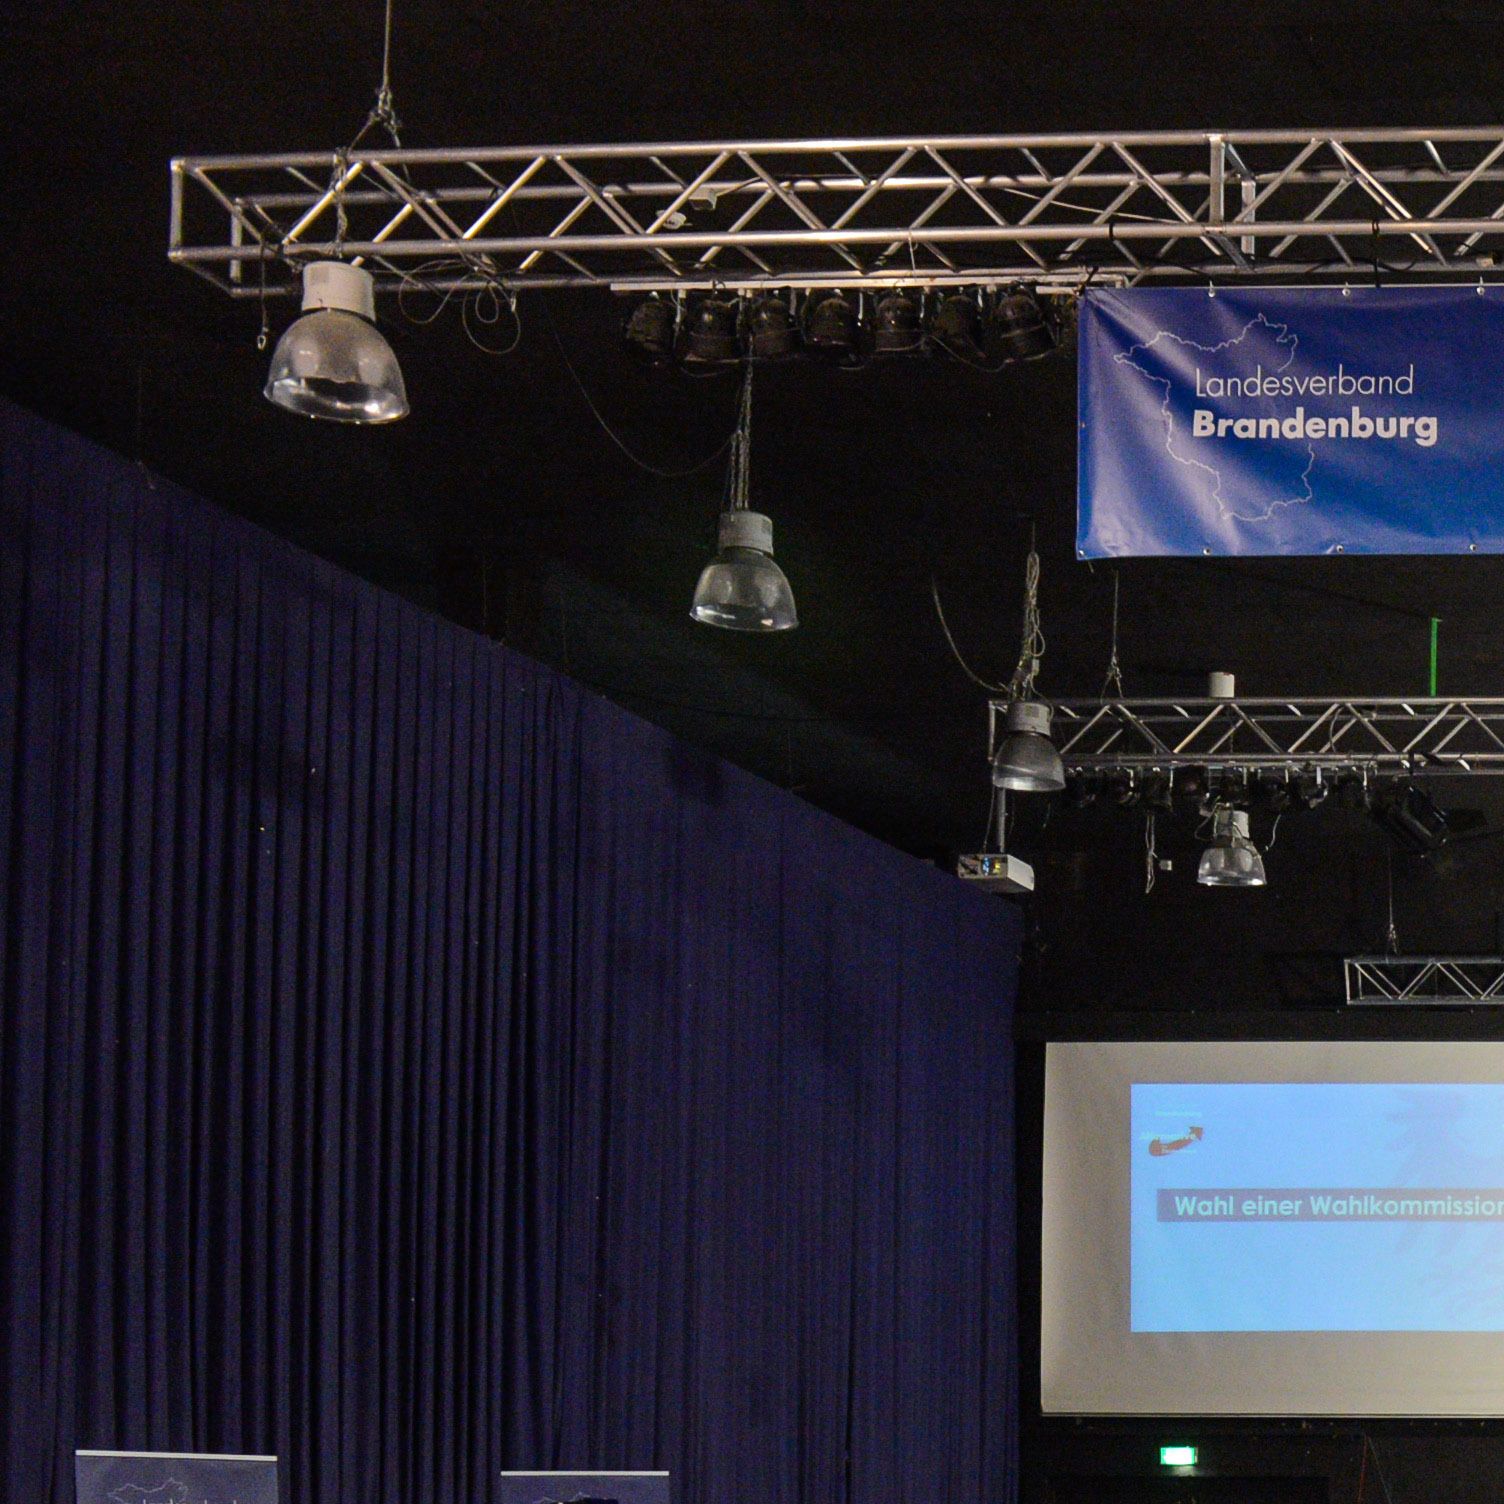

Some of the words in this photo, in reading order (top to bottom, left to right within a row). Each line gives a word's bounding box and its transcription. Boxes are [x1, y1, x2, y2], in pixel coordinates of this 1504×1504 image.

[1195, 363, 1414, 398] Landesverband
[1192, 407, 1438, 447] Brandenburg
[1175, 1195, 1234, 1216] Wahl
[1242, 1196, 1302, 1216] einer
